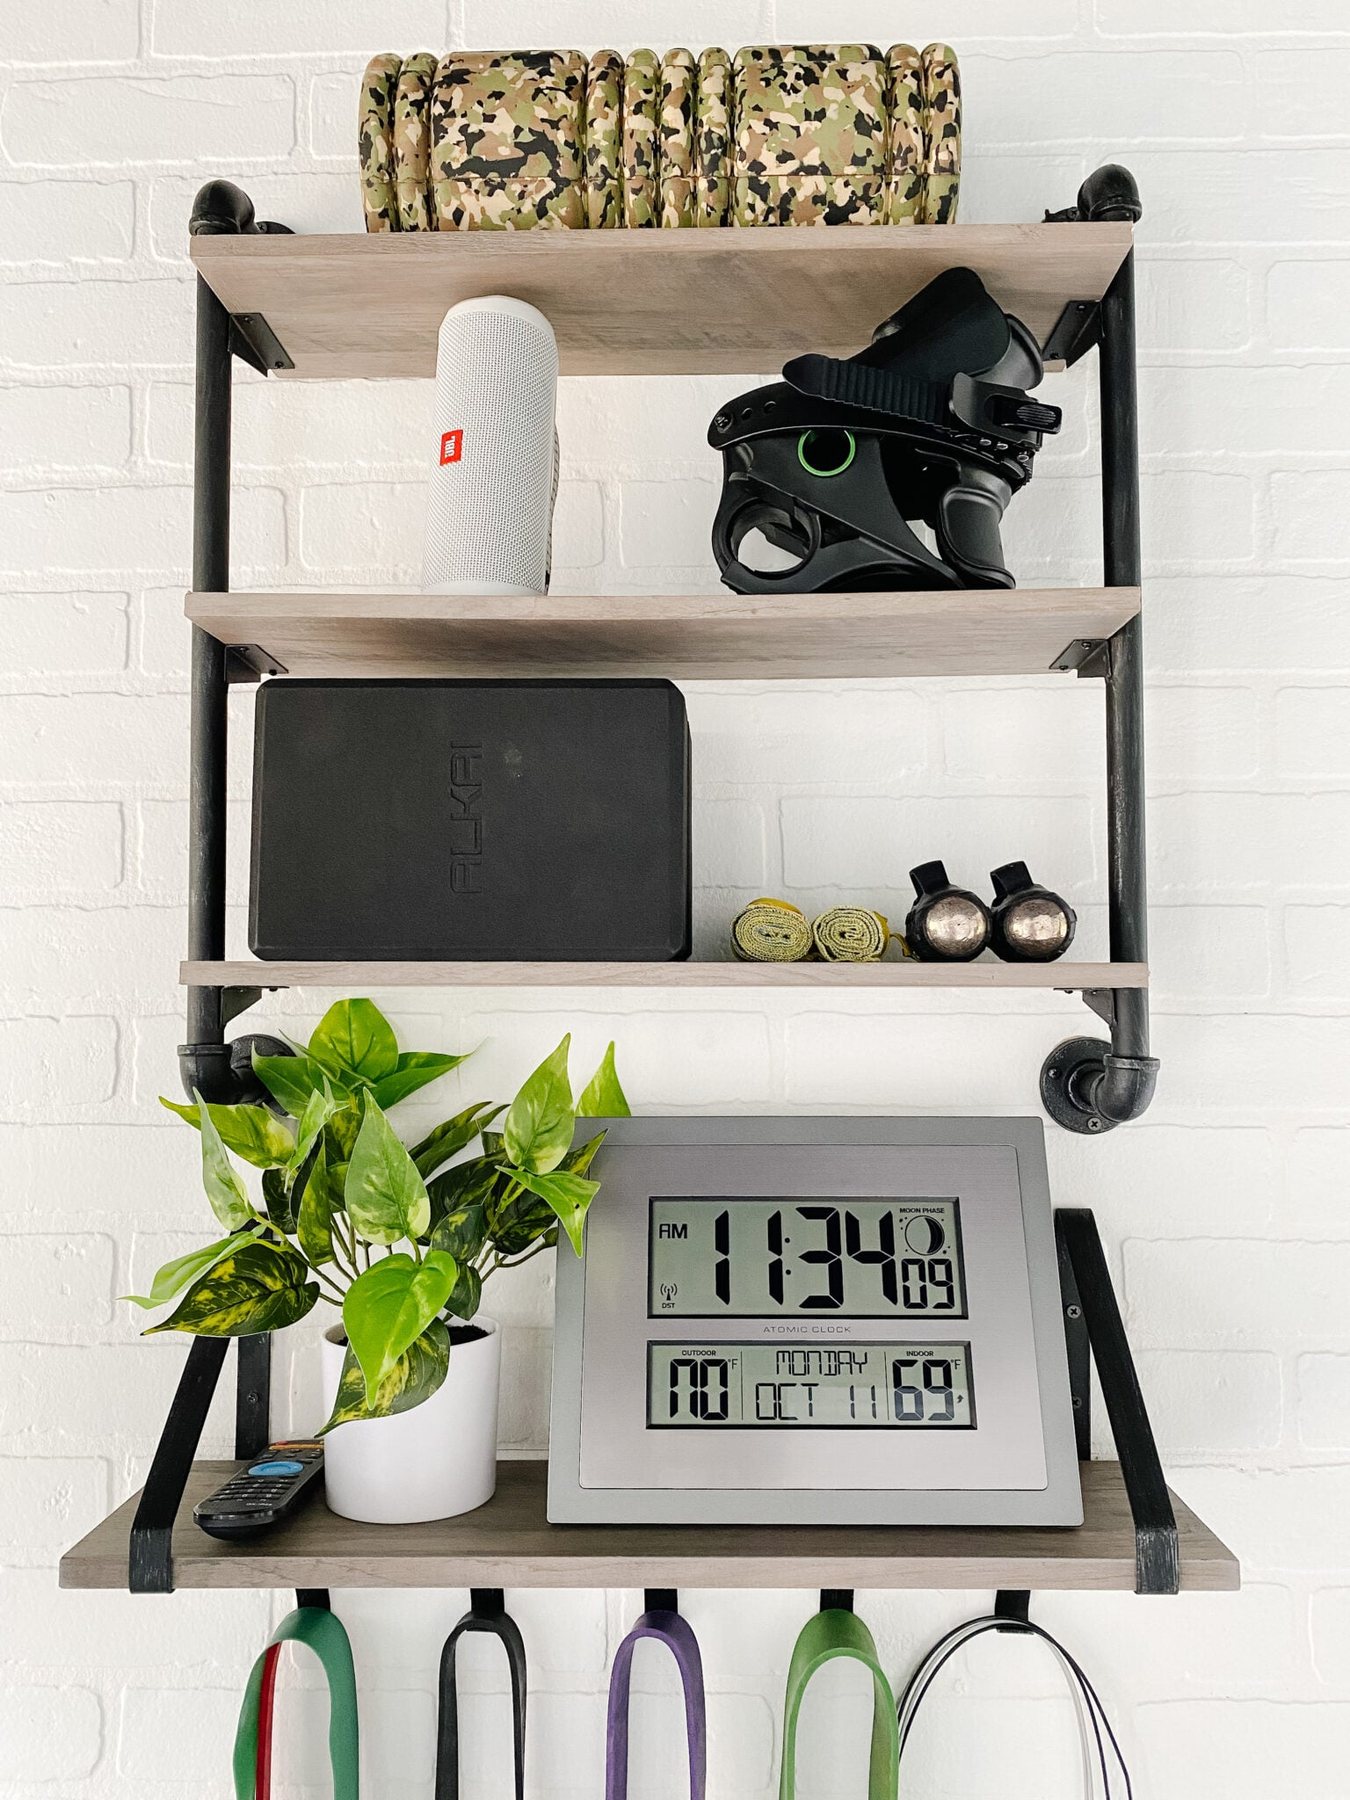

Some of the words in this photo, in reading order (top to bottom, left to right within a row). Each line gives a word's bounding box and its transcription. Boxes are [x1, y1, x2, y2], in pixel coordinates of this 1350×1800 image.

[444, 436, 456, 459] JBL
[450, 740, 483, 894] ALKAI
[659, 1223, 689, 1240] AM
[714, 1206, 899, 1310] 11:34
[901, 1258, 956, 1310] 09
[763, 1326, 808, 1334] ATOMIC
[811, 1326, 852, 1334] CLOCK
[681, 1349, 717, 1357] OUTDOOR
[776, 1350, 868, 1377] MONDAY
[755, 1382, 820, 1421] OCT
[849, 1384, 877, 1420] 11
[892, 1359, 955, 1421] 69
